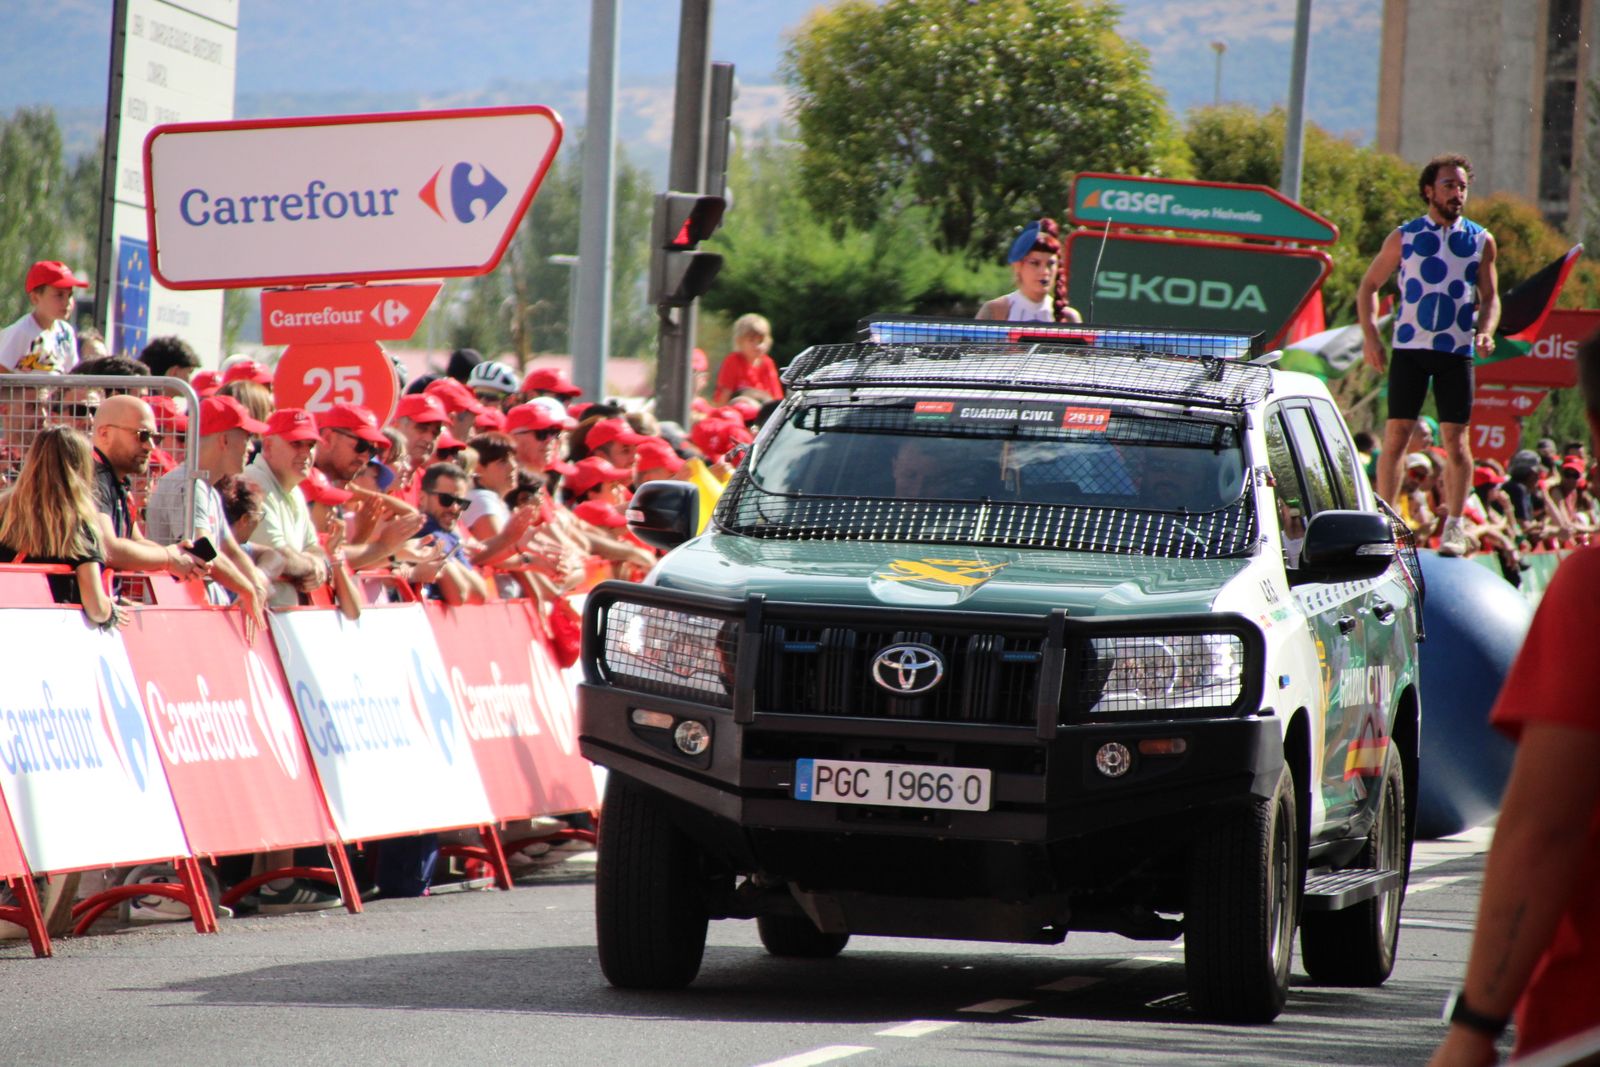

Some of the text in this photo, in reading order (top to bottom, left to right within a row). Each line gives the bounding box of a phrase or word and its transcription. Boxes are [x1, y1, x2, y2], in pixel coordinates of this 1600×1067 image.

[179, 180, 399, 227] Carrefour
[1100, 189, 1262, 223] caser Grupo Helvetia
[269, 306, 364, 328] Carrefour
[302, 365, 365, 413] 25
[960, 407, 1018, 421] GUARDIA
[1020, 409, 1054, 422] CIVIL
[1475, 424, 1506, 448] 75
[146, 674, 259, 766] Carrefour
[295, 673, 411, 757] Carrefour
[451, 661, 541, 741] Carrefour
[816, 765, 870, 798] PGC
[884, 769, 954, 803] 1966
